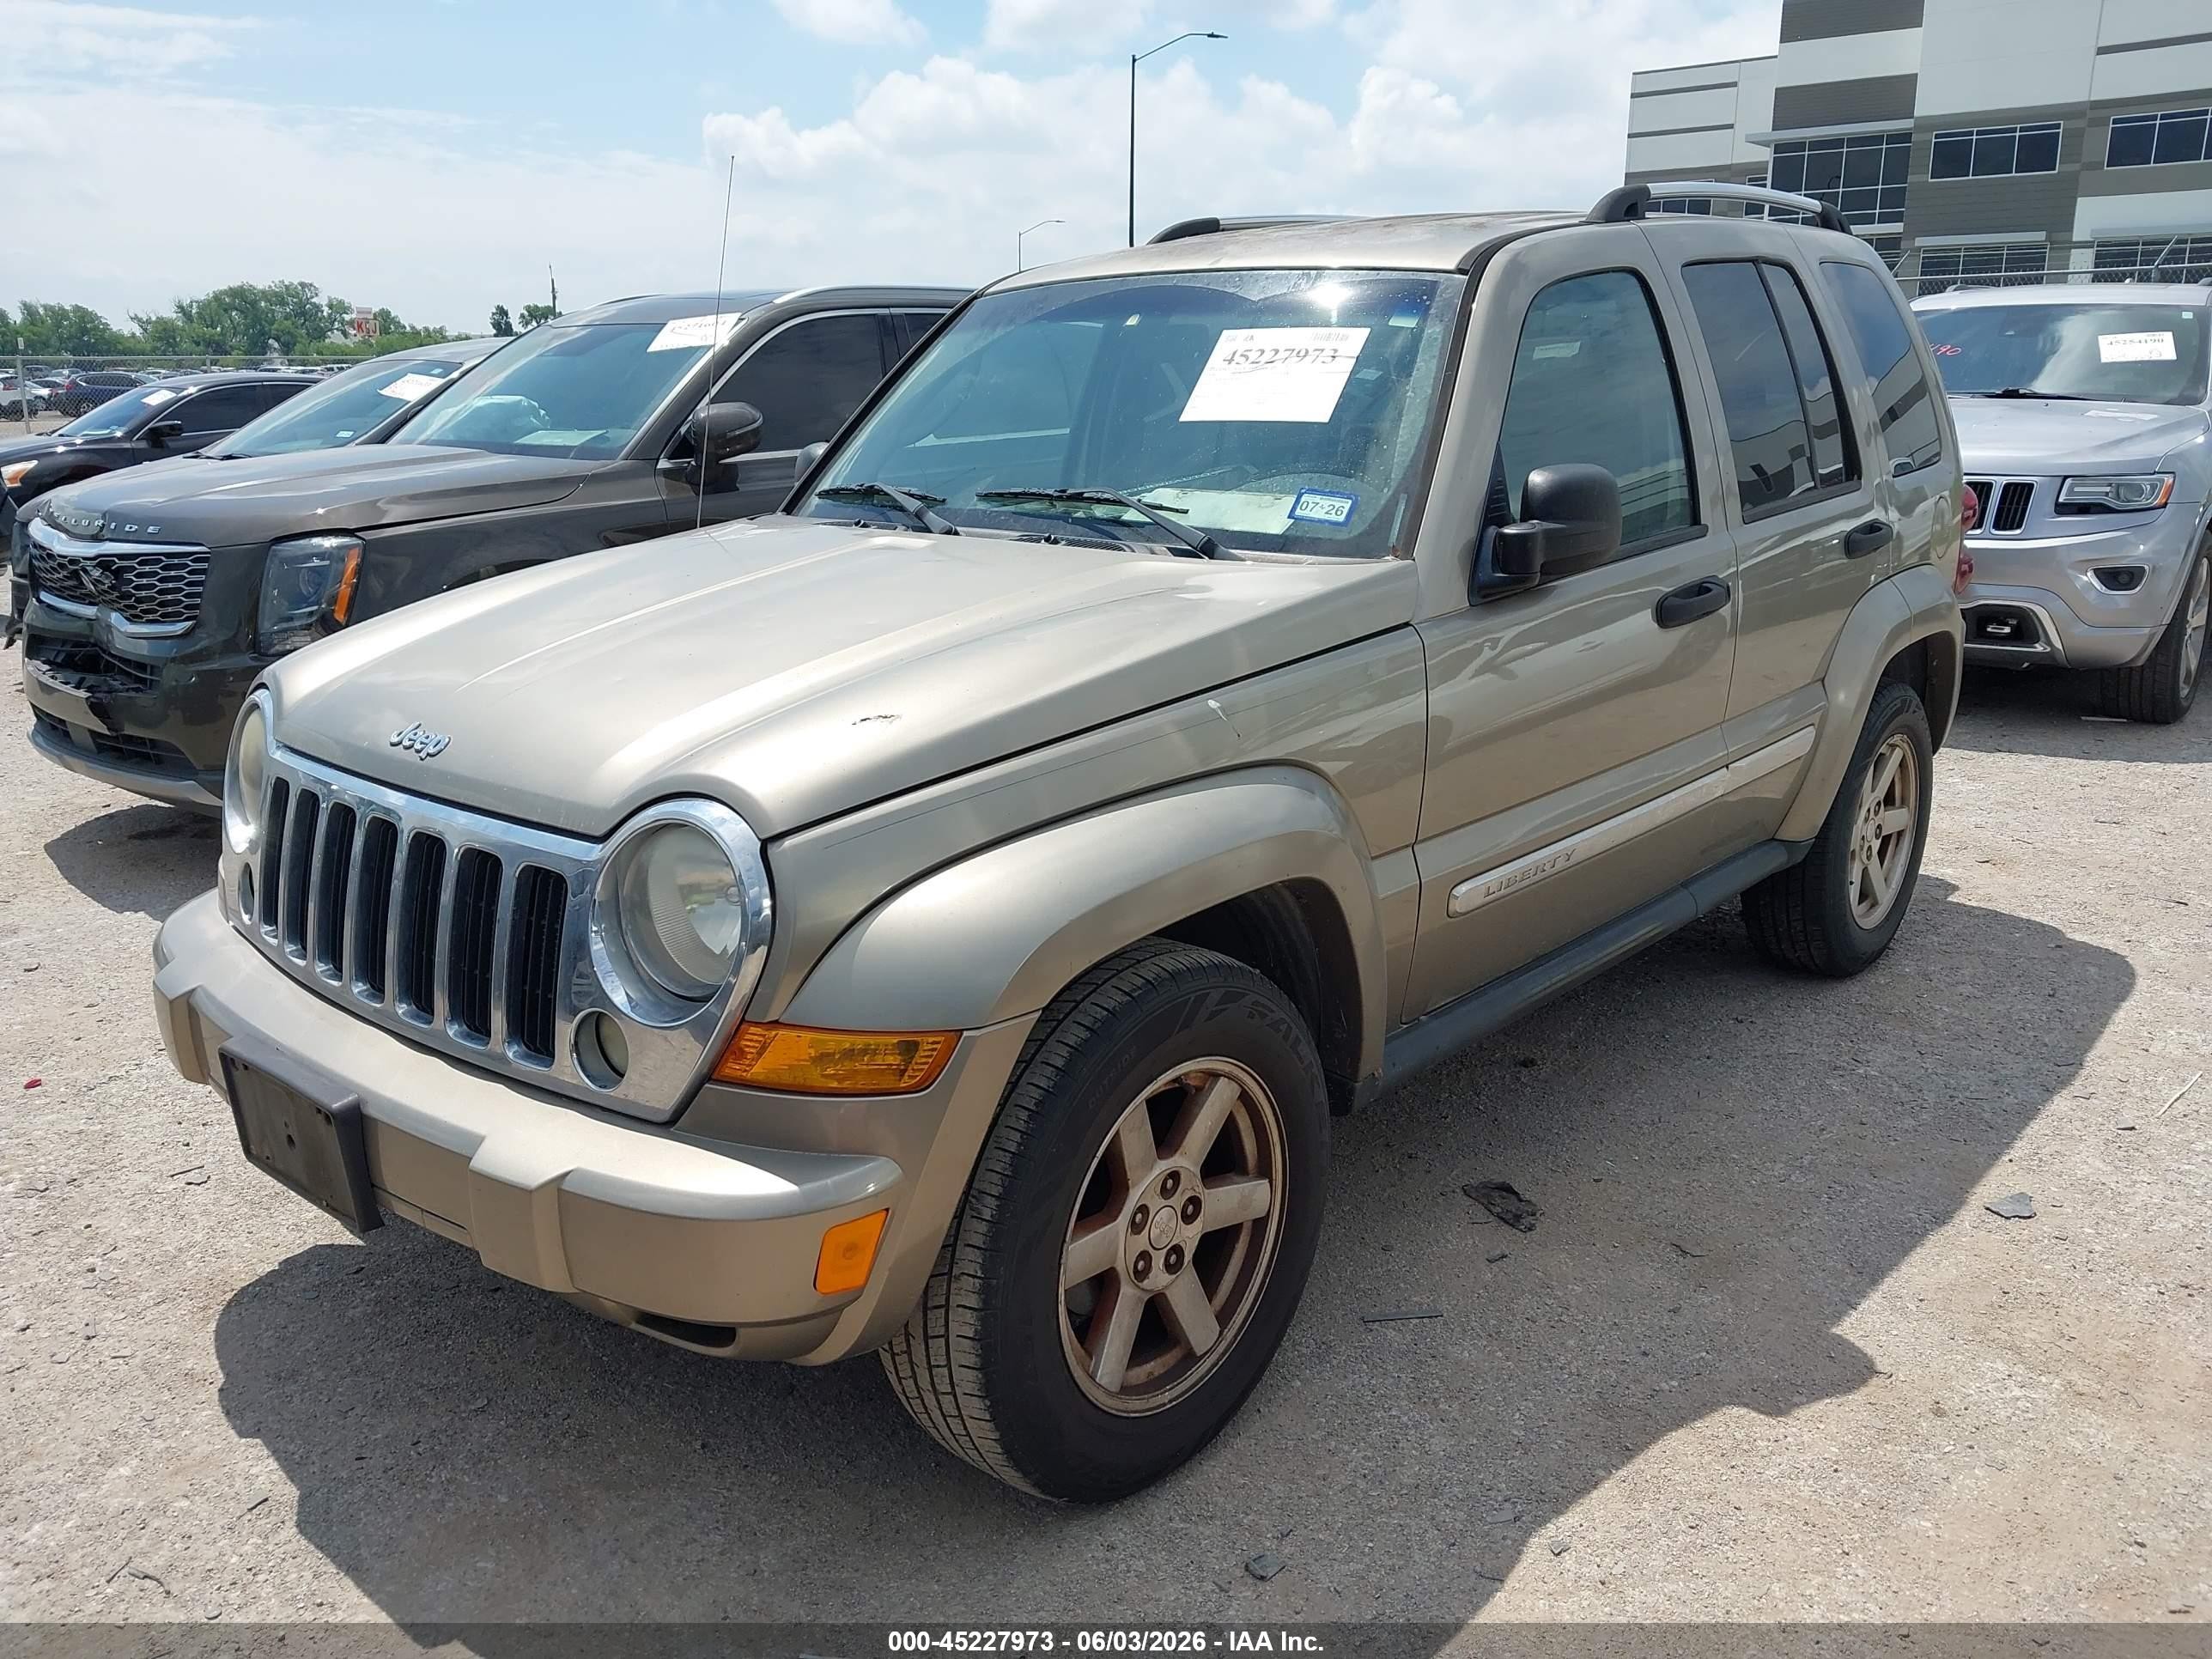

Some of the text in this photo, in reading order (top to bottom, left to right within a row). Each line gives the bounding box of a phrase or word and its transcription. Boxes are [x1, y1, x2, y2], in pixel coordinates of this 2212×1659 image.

[1222, 348, 1339, 365] 45227973
[50, 505, 161, 533] ELLURIDE
[1299, 501, 1346, 516] 07 26
[389, 721, 452, 761] Jeep
[1483, 848, 1577, 898] LIBERTY
